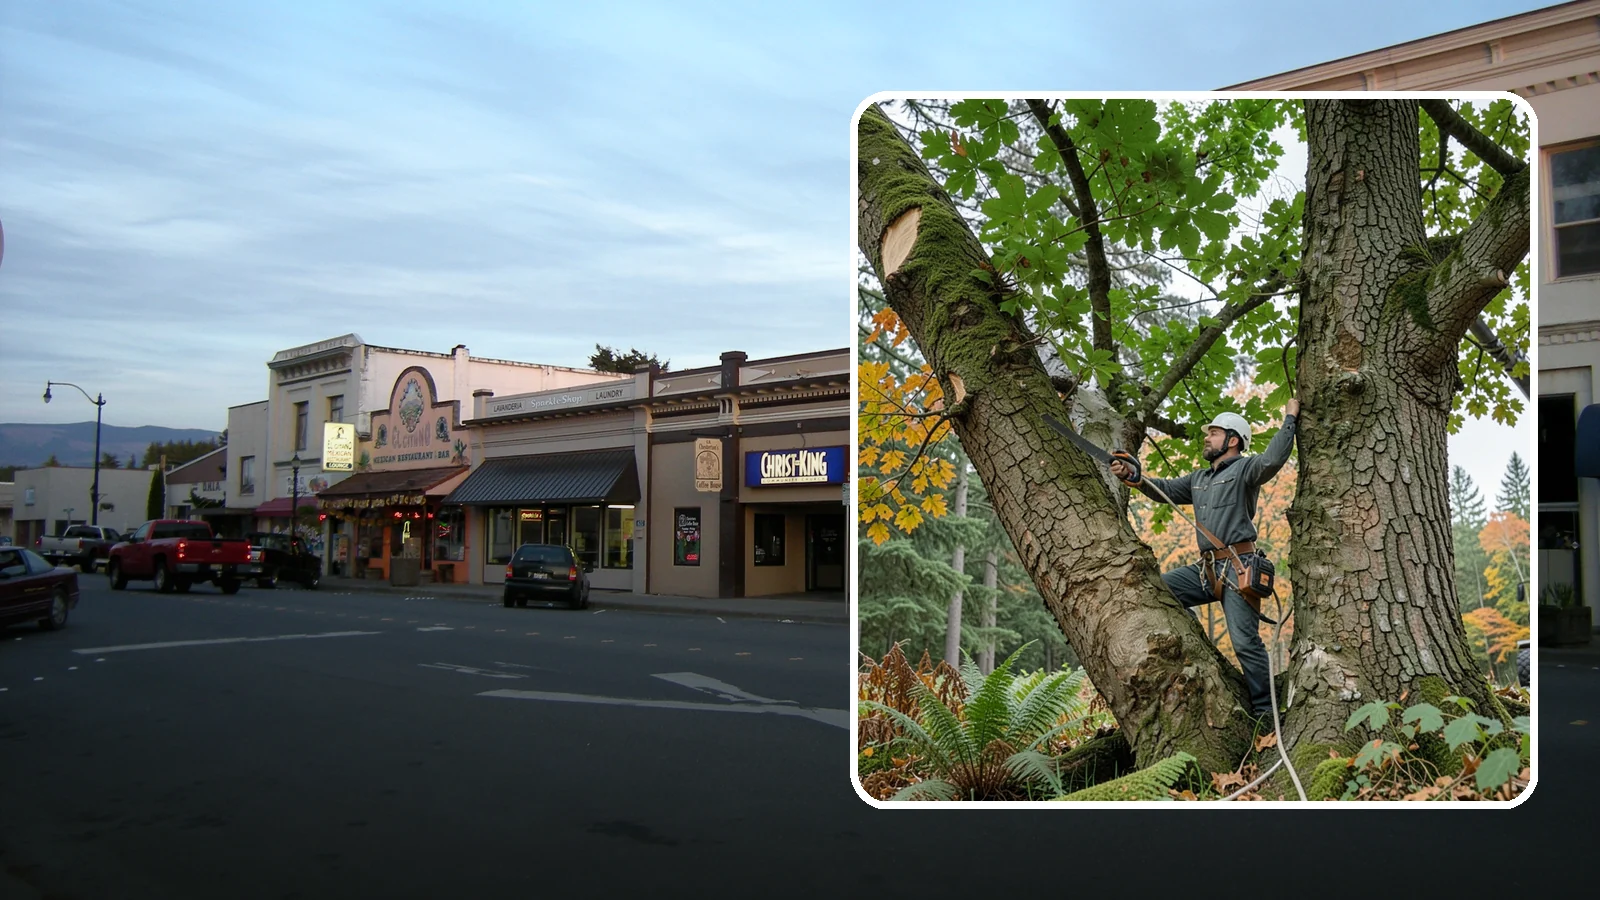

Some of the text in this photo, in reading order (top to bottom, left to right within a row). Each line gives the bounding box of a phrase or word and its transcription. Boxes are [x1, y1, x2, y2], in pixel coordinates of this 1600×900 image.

[595, 389, 623, 400] LAUNDRY
[561, 395, 582, 406] Shop
[493, 402, 522, 413] LAVANDERIA
[373, 454, 396, 464] MEXICAN
[397, 451, 433, 462] RESTAURANT
[437, 450, 450, 459] BAR
[761, 450, 827, 477] CHRIST KING
